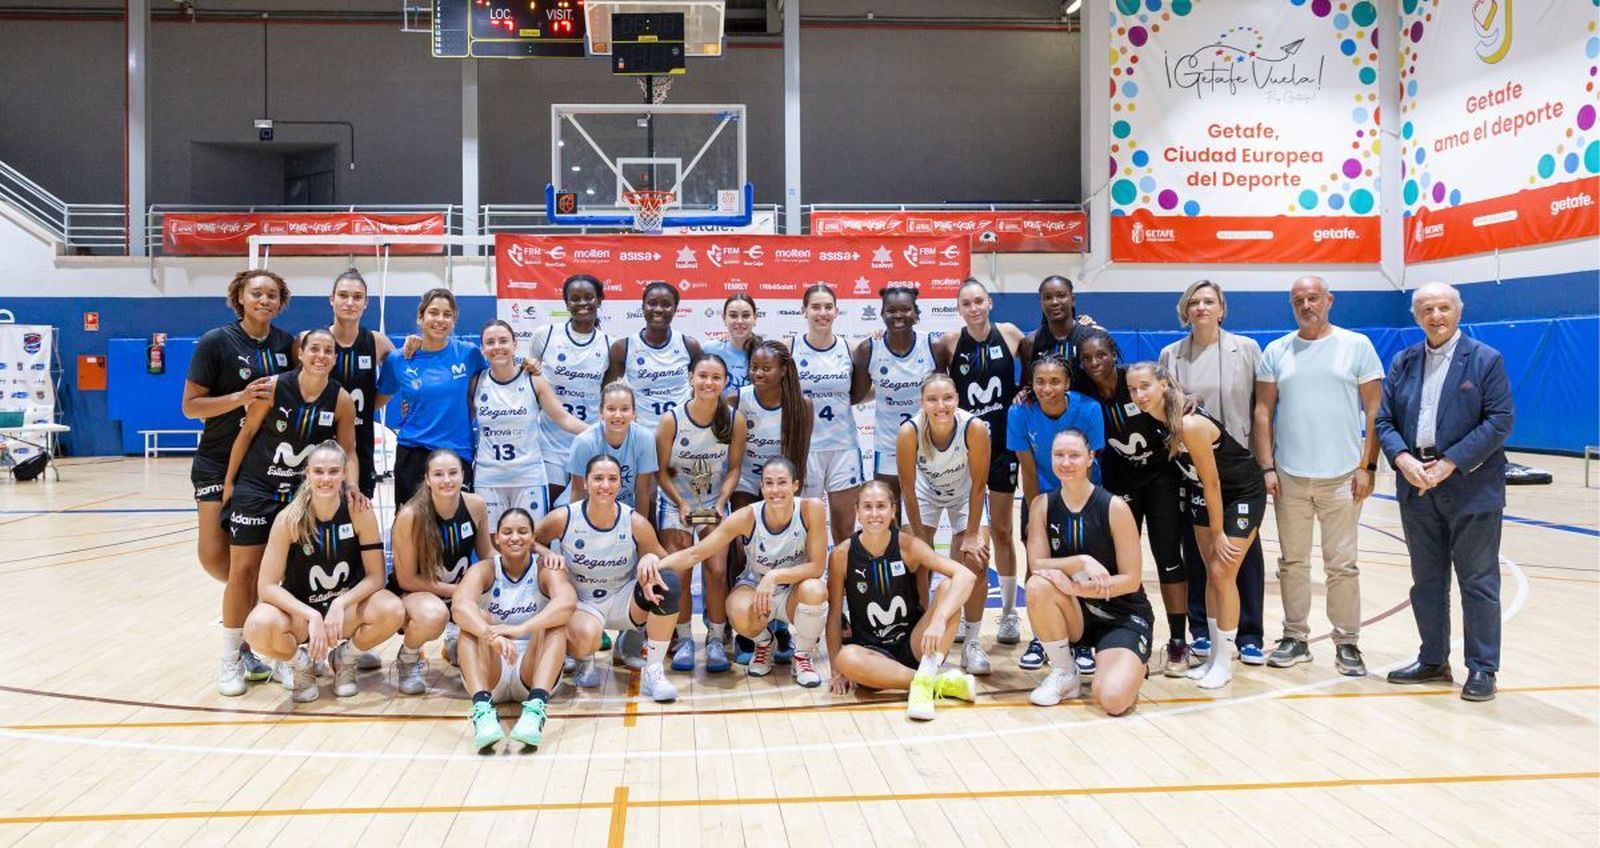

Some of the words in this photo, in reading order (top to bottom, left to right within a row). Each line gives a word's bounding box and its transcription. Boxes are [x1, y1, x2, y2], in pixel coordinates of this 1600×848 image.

[490, 8, 513, 20] LOC.
[546, 8, 574, 20] VISIT.
[1466, 81, 1523, 114] Getafe
[1207, 123, 1280, 142] Getafe,
[1434, 131, 1470, 153] ama
[1473, 120, 1487, 141] el
[1491, 101, 1564, 137] deporte
[1163, 146, 1238, 163] Ciudad
[1242, 148, 1323, 168] Europea
[1186, 171, 1217, 187] del
[1223, 172, 1302, 192] Deporte
[1550, 192, 1596, 215] getafe.
[1145, 230, 1175, 238] GETAFE
[1313, 227, 1360, 243] getafe.
[523, 247, 542, 256] FBM
[574, 249, 611, 259] molten
[619, 251, 653, 262] asisa
[775, 249, 812, 258] molten
[818, 251, 852, 262] asisa
[931, 278, 961, 286] molten
[554, 365, 604, 381] Leganés
[637, 366, 687, 382] Leganés
[799, 370, 849, 383] Leganés
[478, 405, 529, 421] Leganés
[818, 404, 835, 421] 4
[492, 443, 516, 461] 13
[572, 554, 628, 570] Leganés
[487, 601, 538, 620] Leganés
